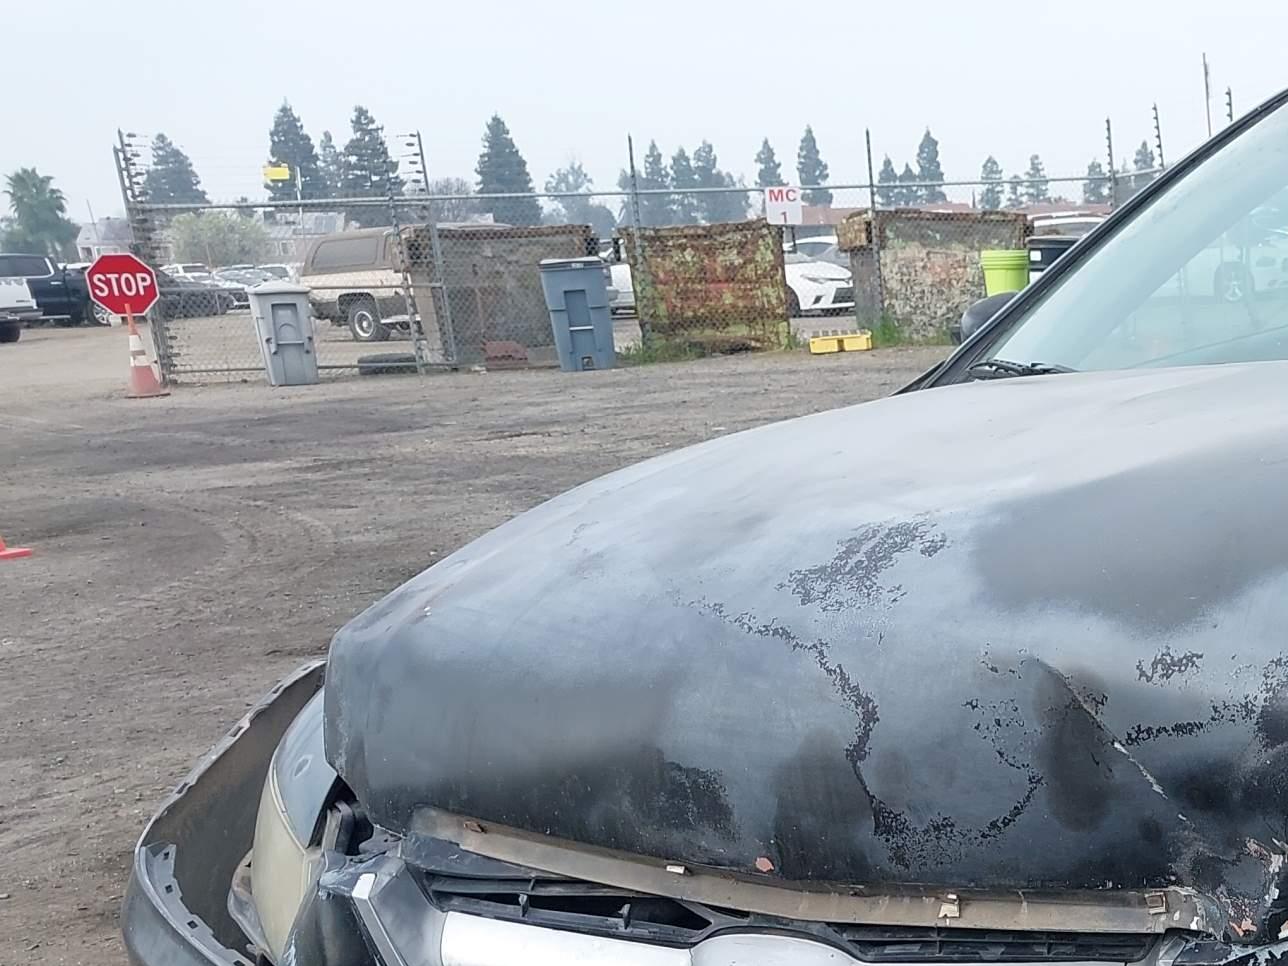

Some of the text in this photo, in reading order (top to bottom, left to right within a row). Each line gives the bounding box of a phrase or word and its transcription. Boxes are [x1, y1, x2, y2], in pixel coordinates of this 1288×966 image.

[768, 188, 797, 203] MC
[780, 211, 788, 224] 1
[93, 273, 151, 297] STOP
